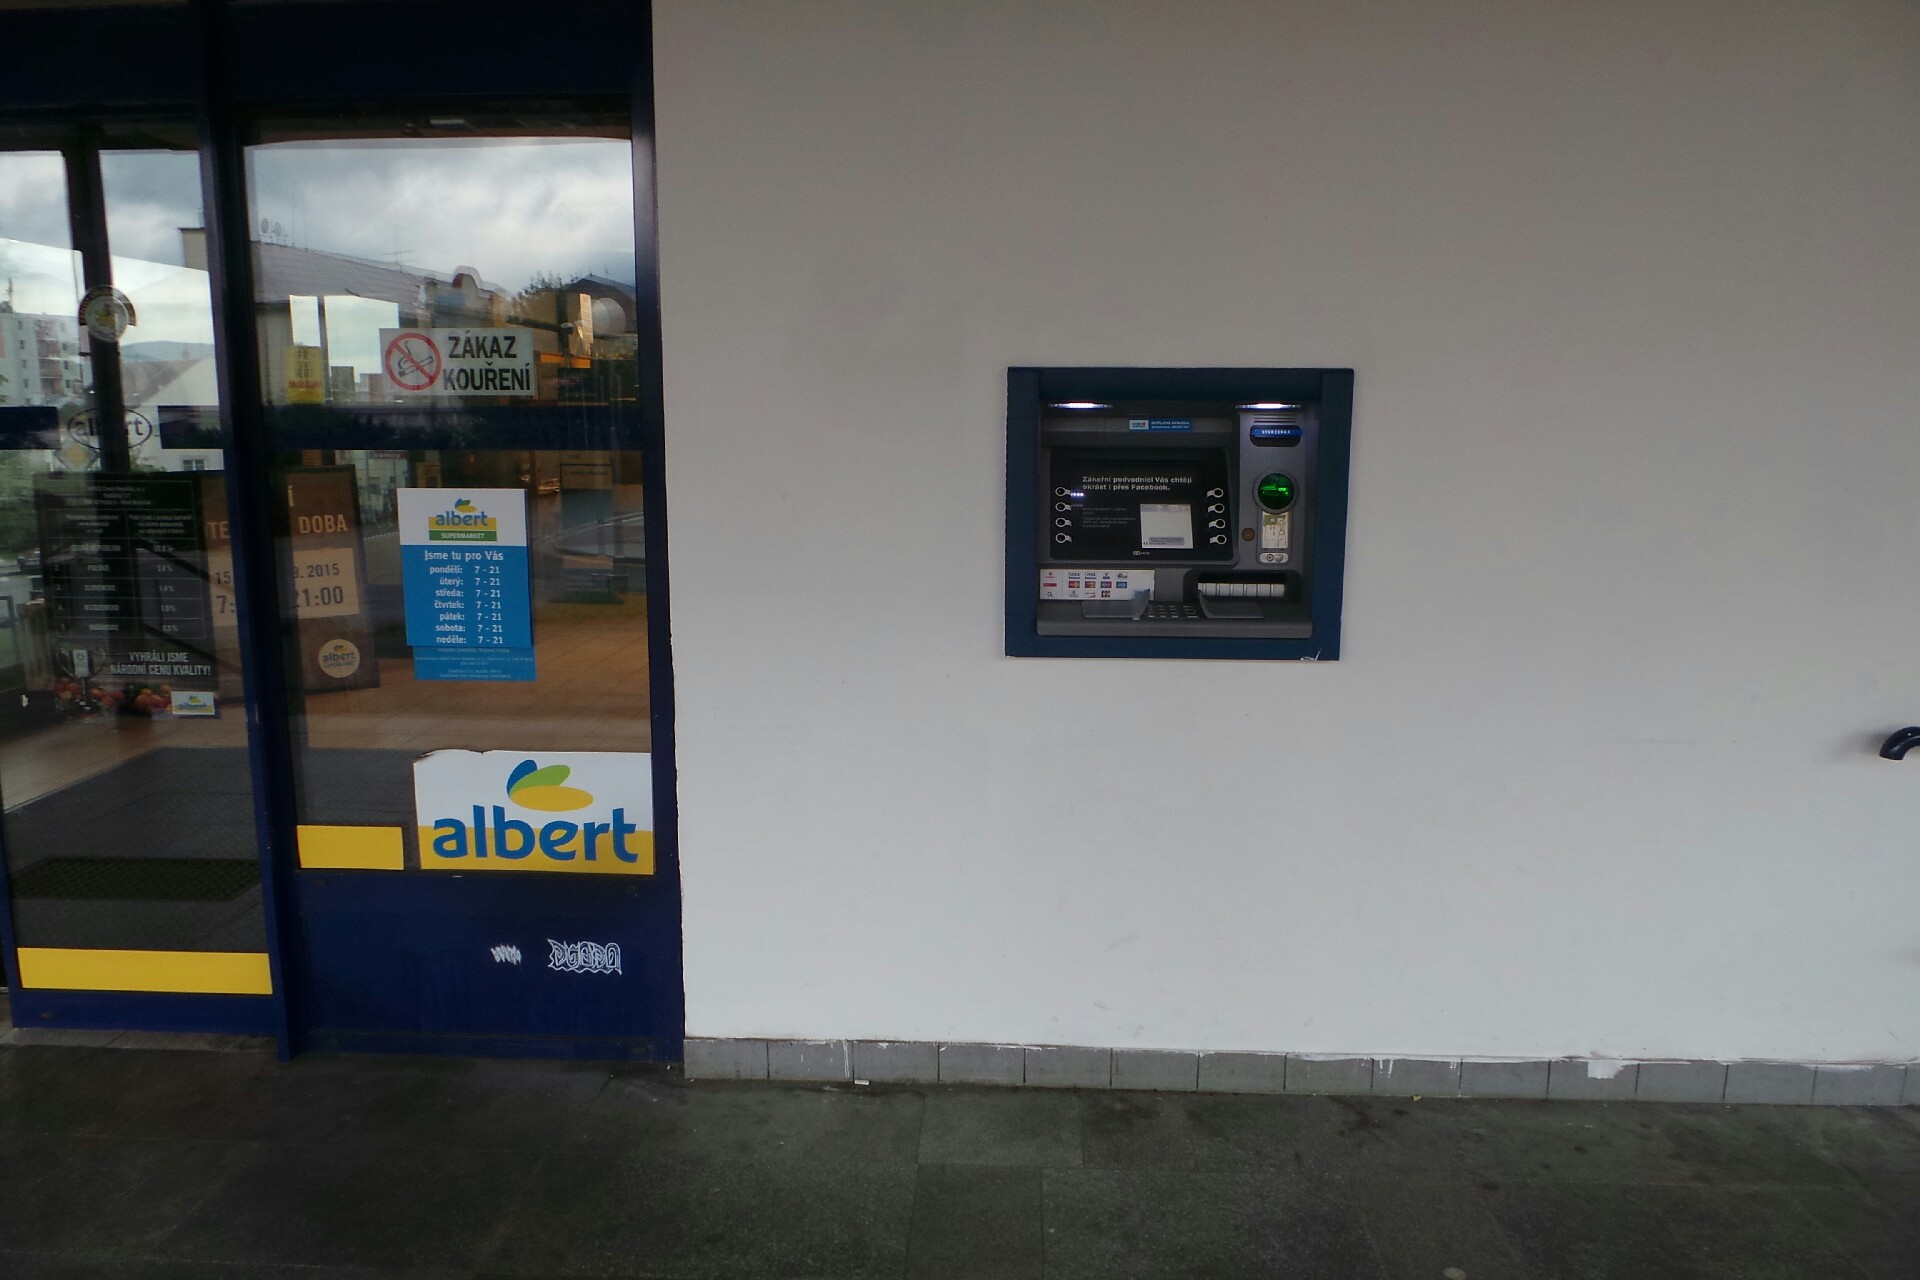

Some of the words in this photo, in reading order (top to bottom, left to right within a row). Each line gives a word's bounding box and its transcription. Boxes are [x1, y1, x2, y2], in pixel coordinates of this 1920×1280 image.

[448, 330, 517, 359] ZÁKAZ
[443, 362, 531, 391] KOUŘENÍ
[298, 514, 348, 534] DOBA
[435, 510, 489, 526] albert
[441, 532, 485, 540] SUPERMARKET
[424, 550, 449, 561] Jsme
[452, 550, 461, 560] tu
[465, 552, 482, 563] pro
[484, 550, 504, 561] Vás
[307, 563, 340, 578] 2015
[429, 565, 463, 575] pondělí:
[474, 566, 481, 574] 7
[489, 566, 500, 574] 21
[439, 577, 464, 587] úterý:
[475, 578, 481, 586] 7
[489, 578, 501, 586] 21
[435, 588, 464, 597] středa:
[475, 589, 481, 597] 7
[490, 589, 501, 597] 21
[434, 599, 465, 609] čtvrtek:
[475, 601, 482, 609] 7
[490, 601, 501, 609] 21
[439, 612, 465, 621] pátek:
[476, 613, 483, 621] 7
[491, 613, 502, 621] 21
[435, 624, 466, 632] sobota:
[436, 635, 467, 644] neděle:
[477, 636, 484, 644] 7
[492, 636, 503, 644] 21
[129, 649, 165, 662] VYHRÁLI
[167, 652, 189, 662] JSME
[110, 661, 147, 675] NÁRODNÍ
[148, 664, 171, 675] CENU
[173, 664, 212, 676] KVALITY!
[433, 804, 638, 863] albert
